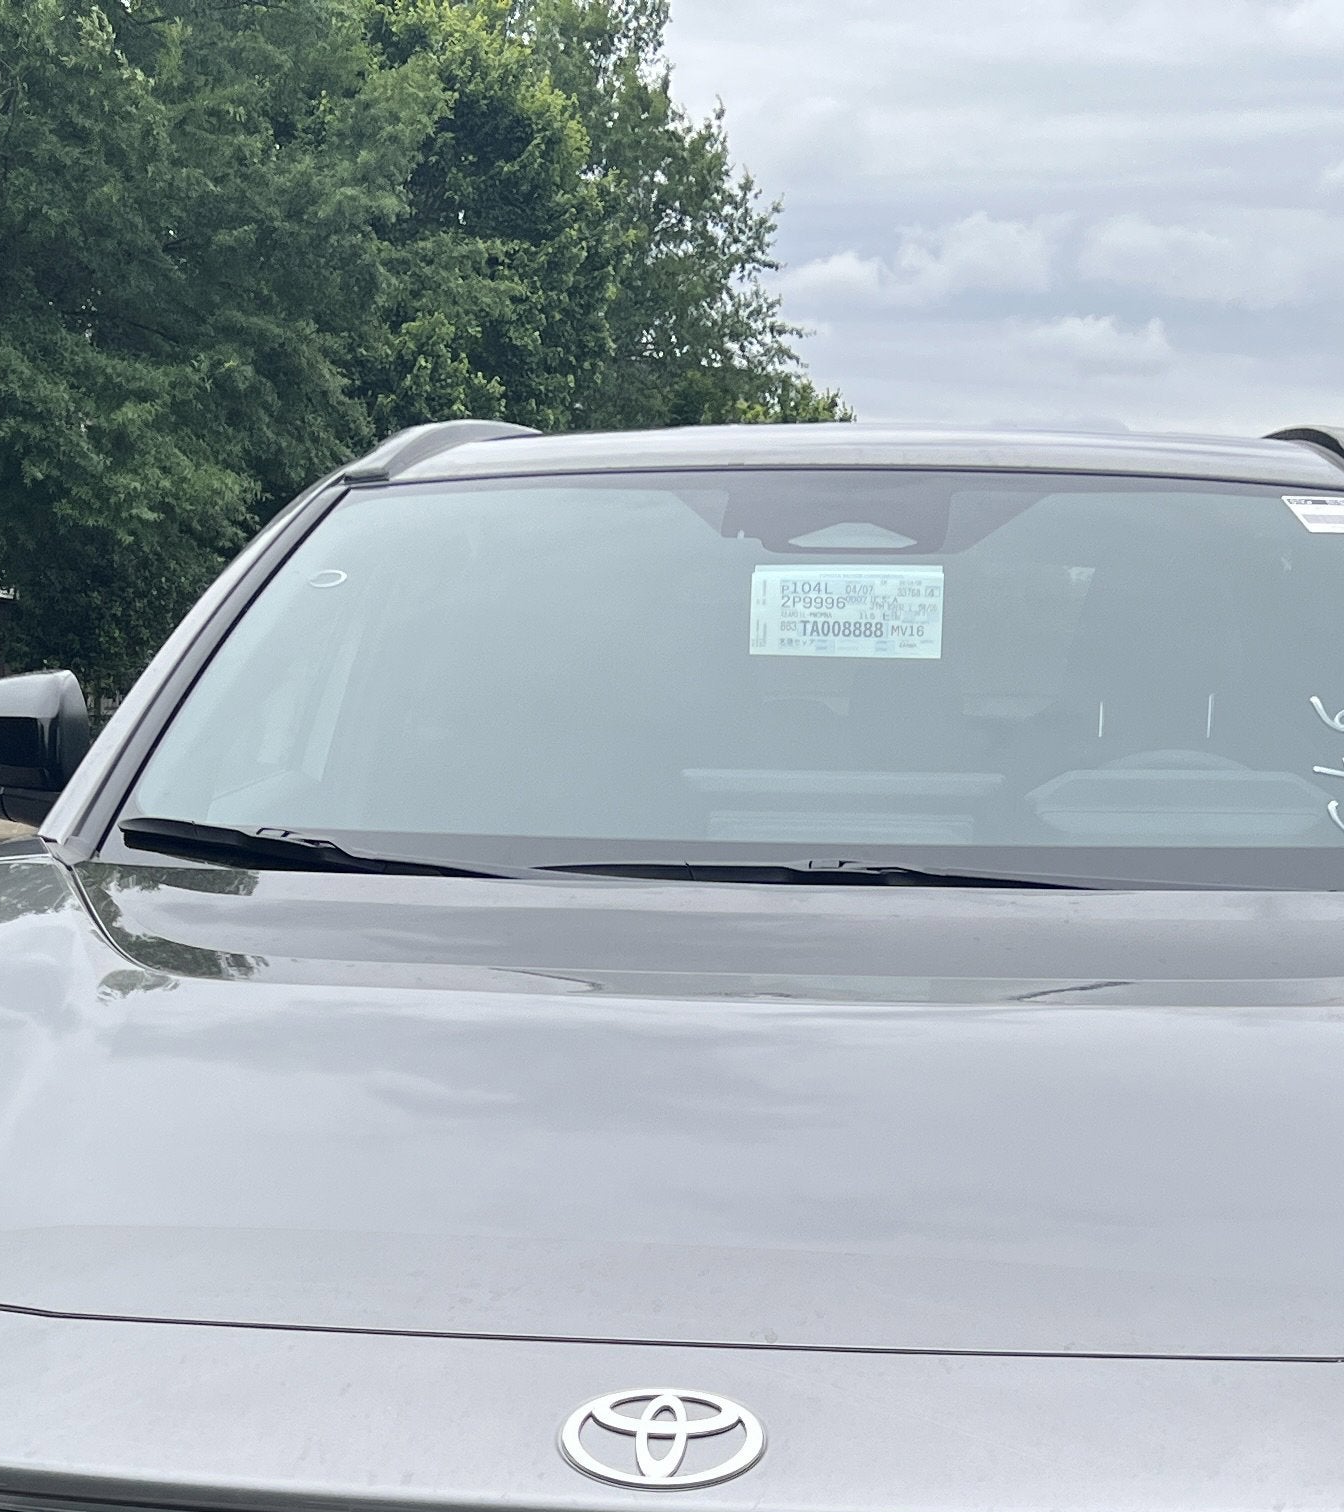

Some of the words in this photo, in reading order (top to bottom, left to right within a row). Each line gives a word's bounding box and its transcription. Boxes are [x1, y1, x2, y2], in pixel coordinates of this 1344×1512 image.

[781, 594, 846, 610] 2P9996
[799, 619, 884, 638] TA008888
[890, 624, 926, 638] MV16
